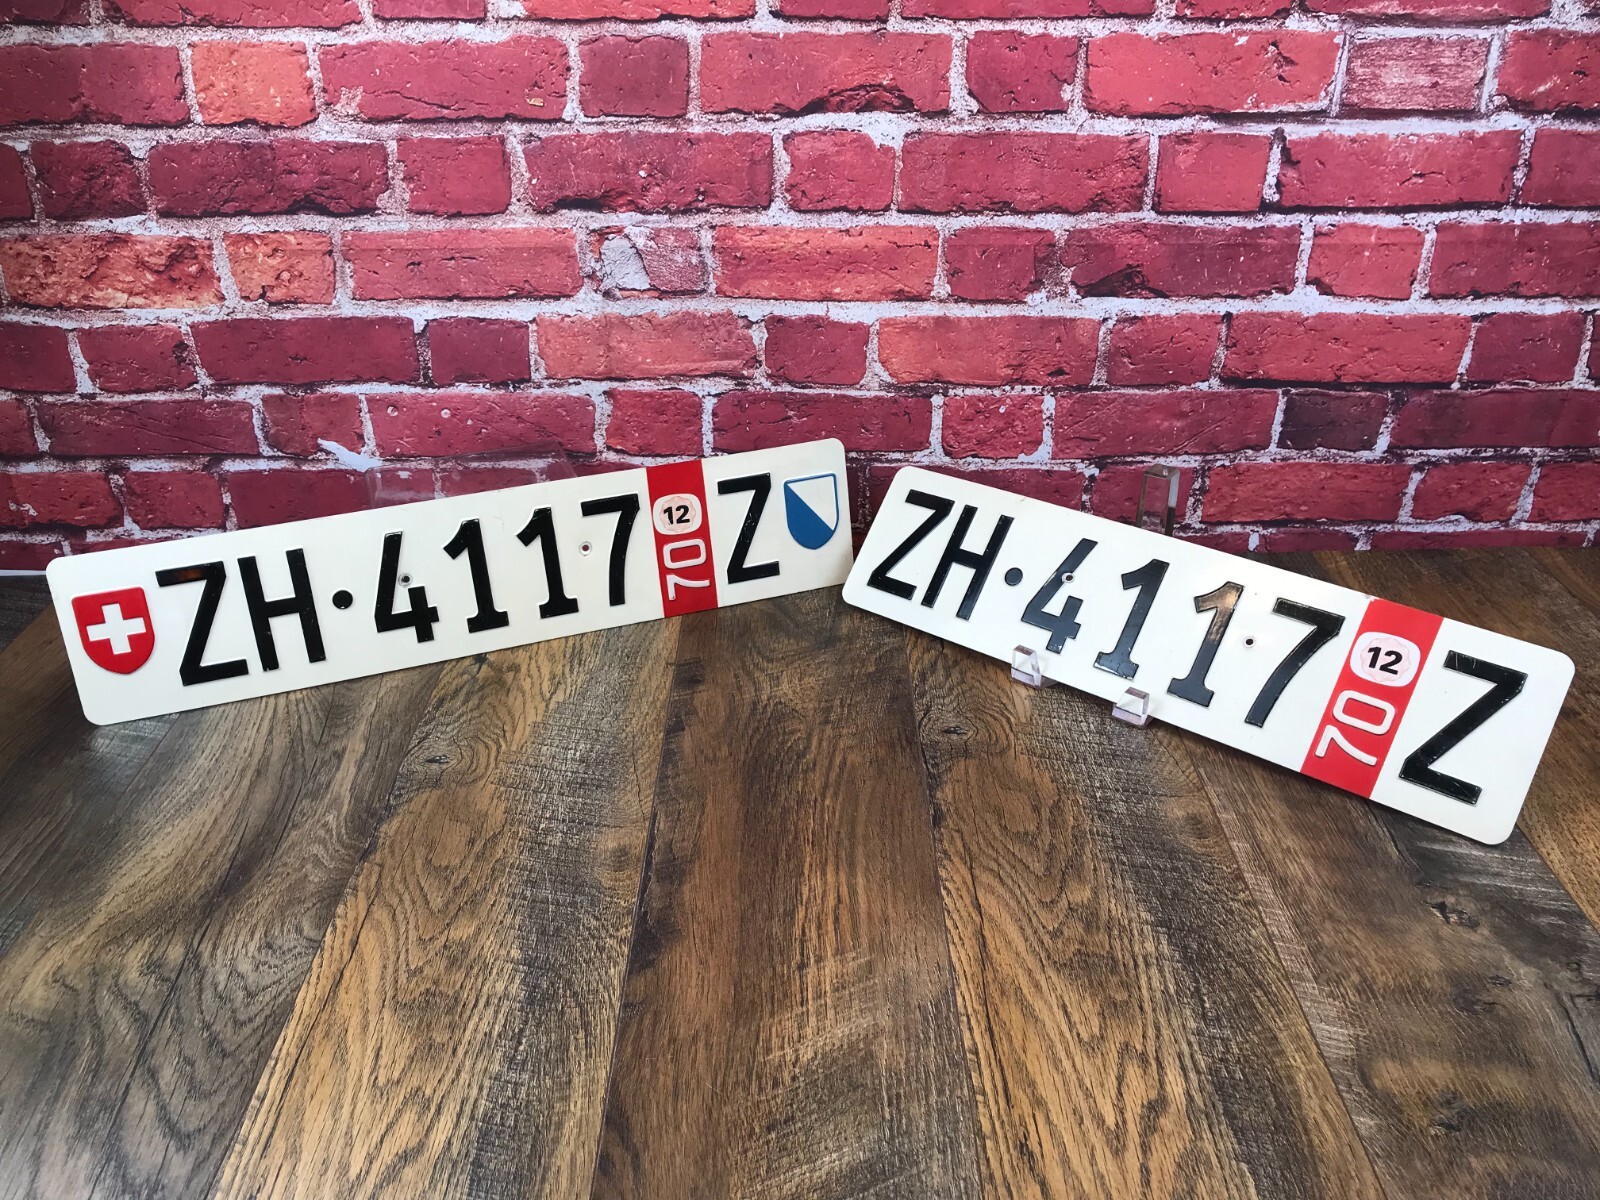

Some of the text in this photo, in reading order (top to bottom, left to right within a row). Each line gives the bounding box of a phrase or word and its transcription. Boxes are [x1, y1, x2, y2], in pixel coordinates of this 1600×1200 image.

[663, 504, 690, 525] 12
[717, 472, 780, 584] Z
[662, 538, 710, 601] 70
[1367, 646, 1403, 675] 12
[1314, 690, 1396, 766] 70
[1399, 649, 1529, 806] Z
